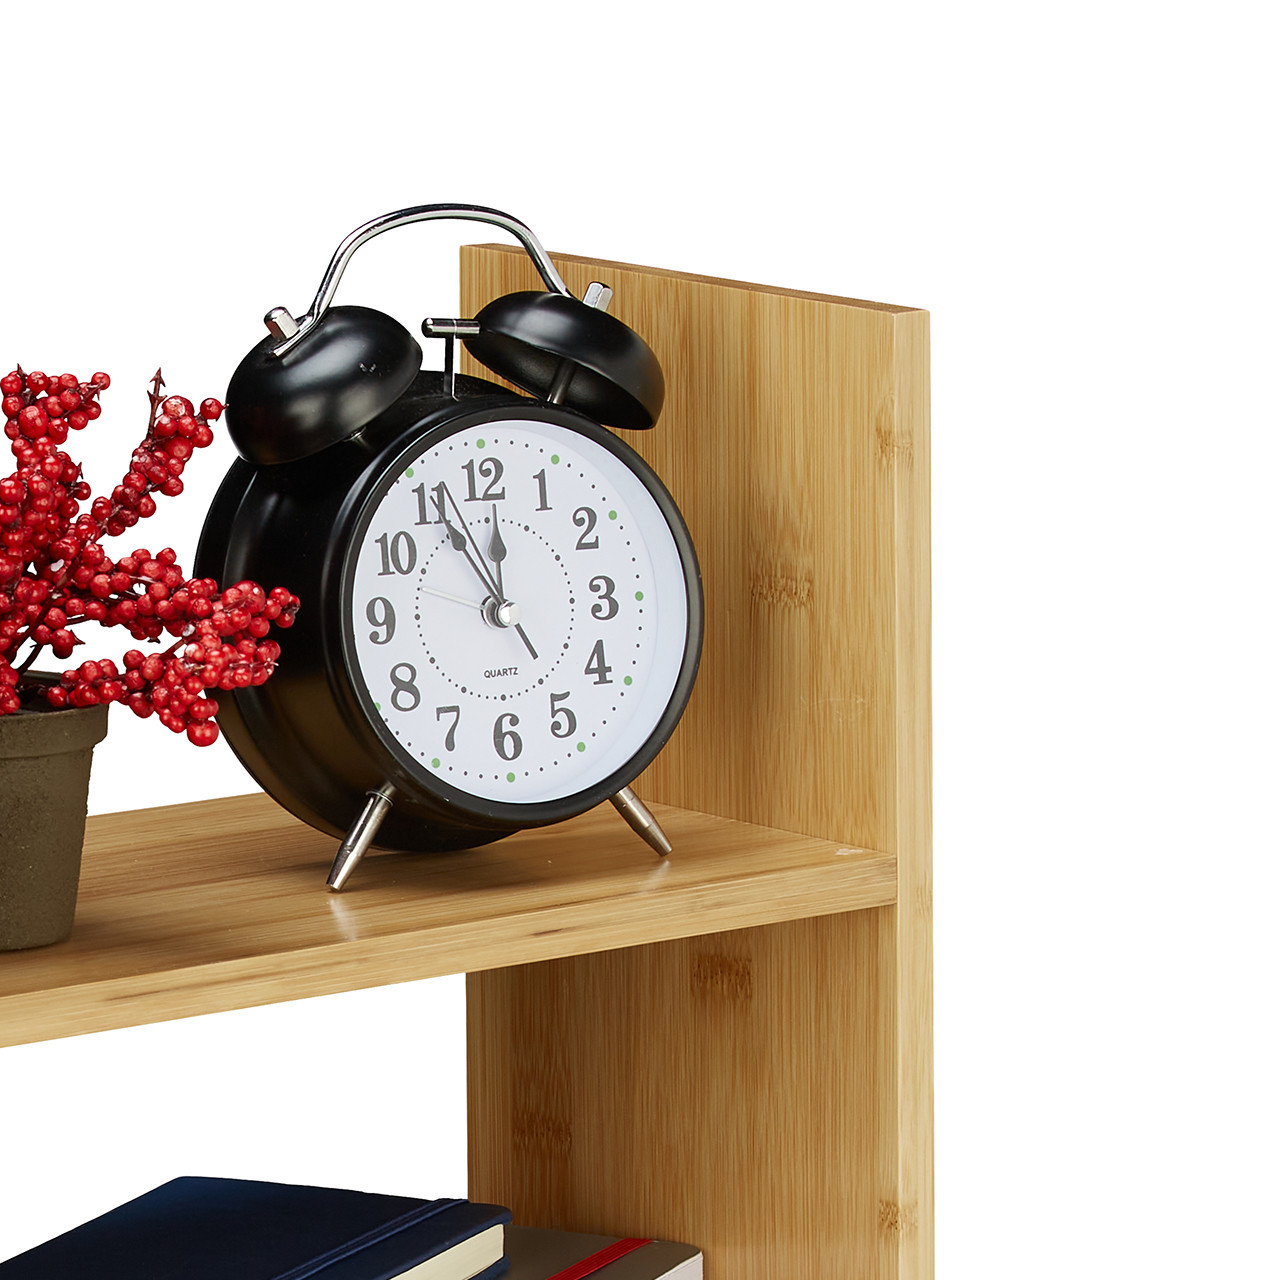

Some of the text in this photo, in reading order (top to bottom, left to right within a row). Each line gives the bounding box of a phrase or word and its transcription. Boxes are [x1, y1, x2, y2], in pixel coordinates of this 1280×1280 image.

[462, 458, 506, 502] 12
[532, 469, 553, 511] 1
[412, 481, 452, 526] 11
[572, 506, 599, 551] 2
[375, 530, 418, 576] 10
[589, 575, 619, 620] 3
[366, 597, 396, 645] 9
[483, 666, 519, 679] QUARTZ
[584, 639, 613, 685] 4
[390, 663, 421, 712] 8
[436, 705, 461, 751] 7
[493, 713, 523, 761] 6
[550, 691, 577, 738] 5
